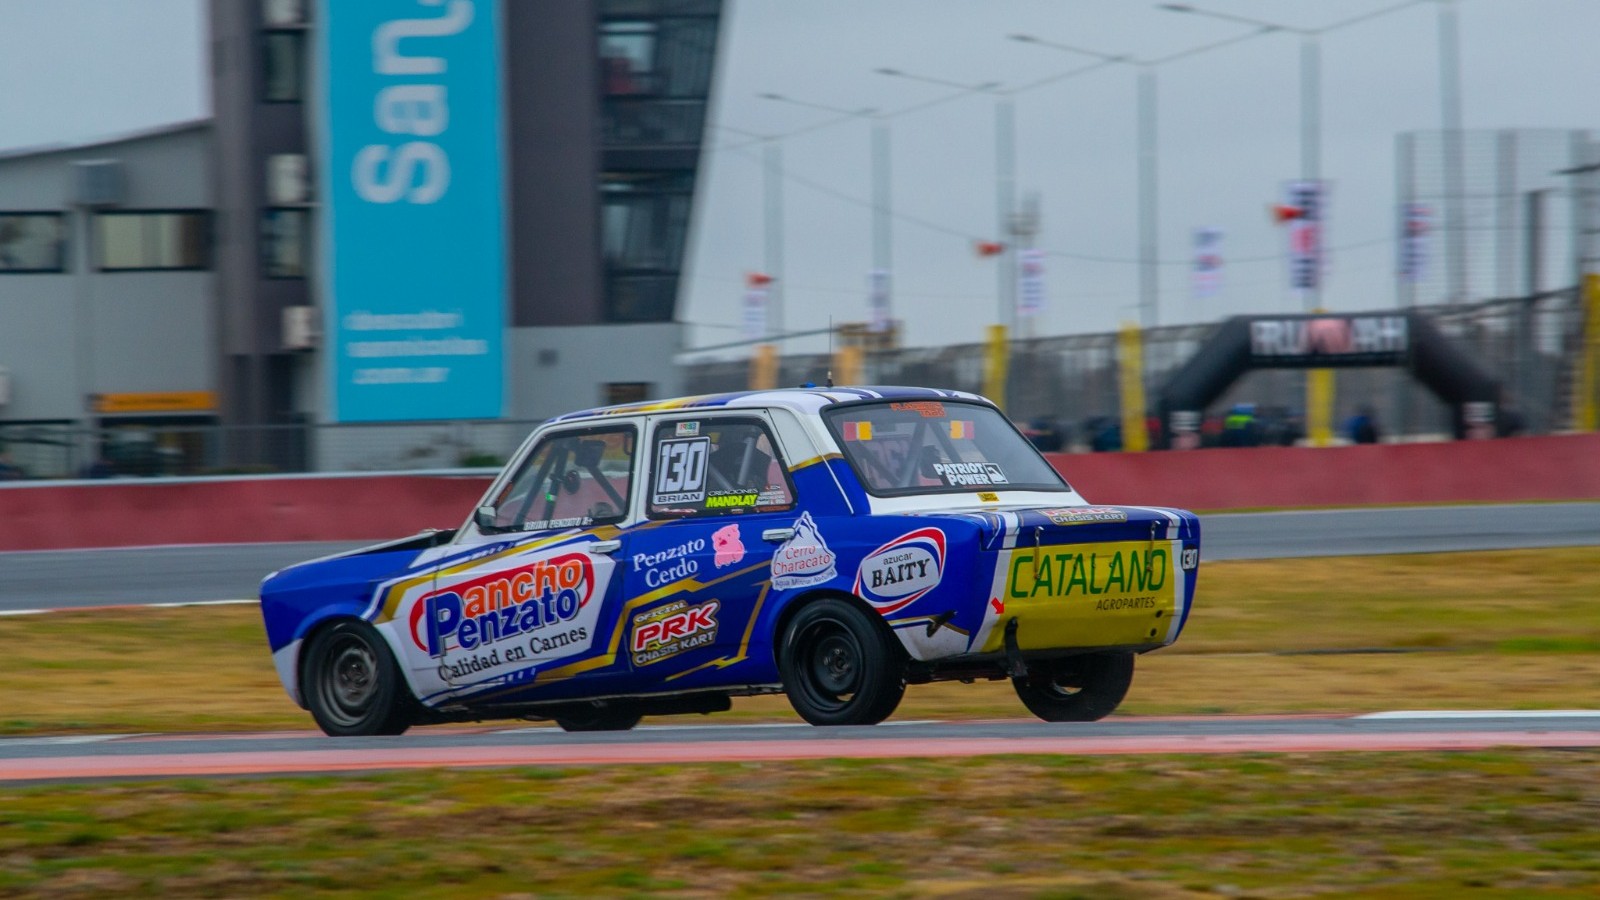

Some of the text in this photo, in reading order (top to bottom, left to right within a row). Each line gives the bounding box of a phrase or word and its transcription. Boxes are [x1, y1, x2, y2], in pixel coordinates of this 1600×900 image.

[658, 441, 707, 493] 130
[933, 462, 985, 475] PATRIOT
[946, 473, 991, 486] POWER
[658, 493, 700, 503] BRIAN
[706, 494, 758, 508] MANDLAY
[1095, 512, 1126, 521] KART
[632, 538, 706, 572] Penzato
[785, 545, 816, 560] Cerro
[883, 552, 913, 566] azucar
[1182, 549, 1198, 570] 130
[645, 558, 699, 588] Cerdo
[774, 554, 831, 576] Characato
[871, 558, 931, 588] BAITY
[1010, 549, 1167, 598] CATALANO
[1096, 596, 1156, 611] AGROPARTES
[425, 587, 581, 659] Penzato
[634, 602, 718, 652] PRK
[438, 625, 587, 682] Calidad en Carnes
[636, 631, 715, 663] CHASIS KART
